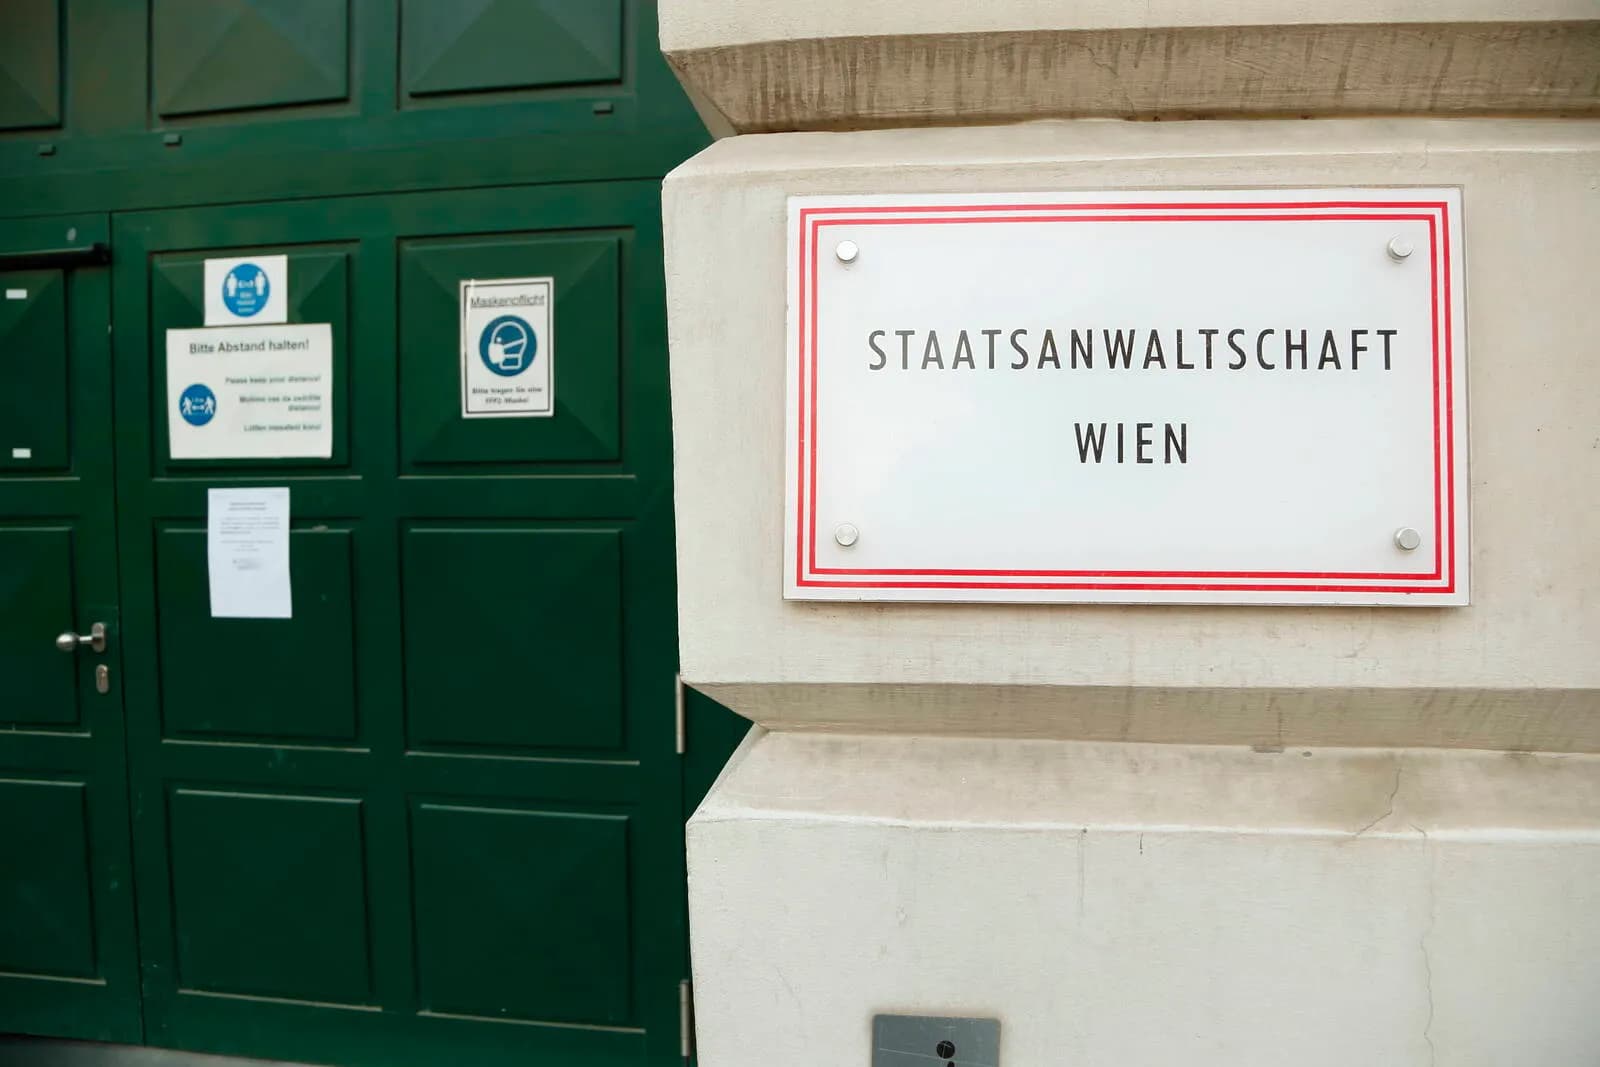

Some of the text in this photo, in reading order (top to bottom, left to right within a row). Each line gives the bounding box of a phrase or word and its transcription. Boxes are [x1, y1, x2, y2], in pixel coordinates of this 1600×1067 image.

[470, 294, 545, 308] Maskenpflicht
[189, 338, 310, 355] Bitte Abstand halten!
[868, 329, 1397, 371] STAATSANWALTSCHAFT
[1074, 423, 1188, 464] WIEN
